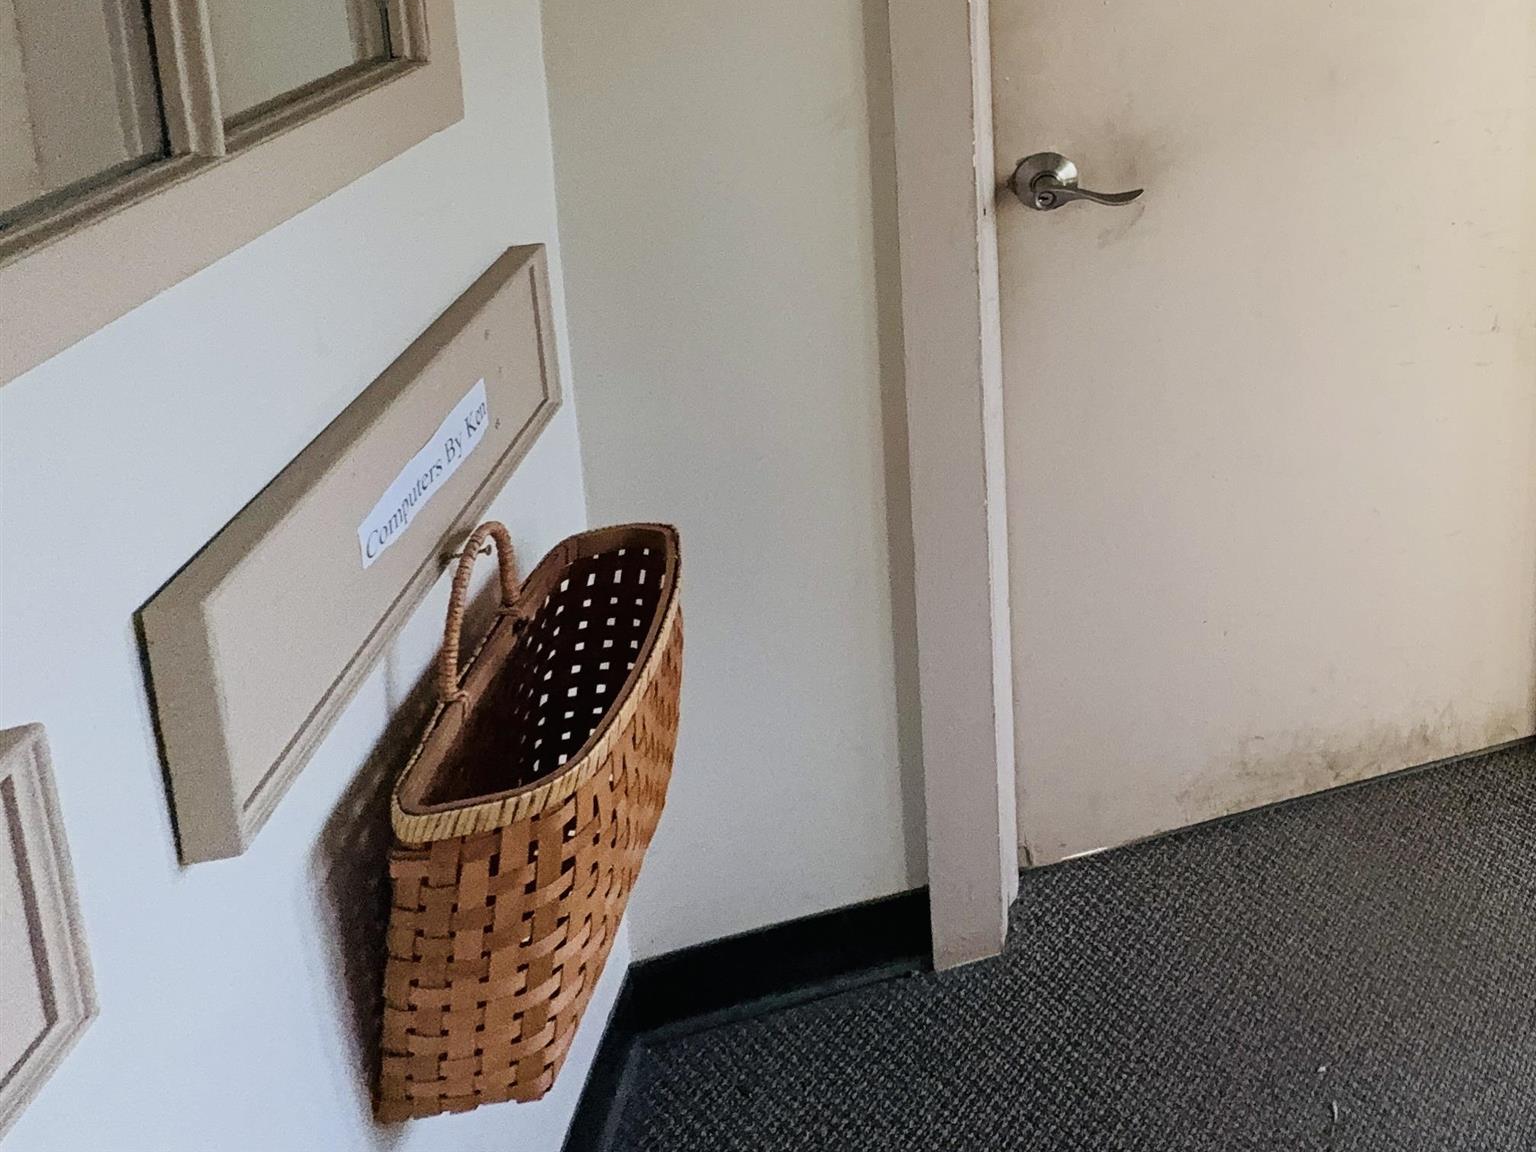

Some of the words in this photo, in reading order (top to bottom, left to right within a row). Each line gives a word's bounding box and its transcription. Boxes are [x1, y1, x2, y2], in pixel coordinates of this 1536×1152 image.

[366, 458, 443, 559] Computers
[444, 432, 463, 464] By
[463, 402, 487, 438] Ken
